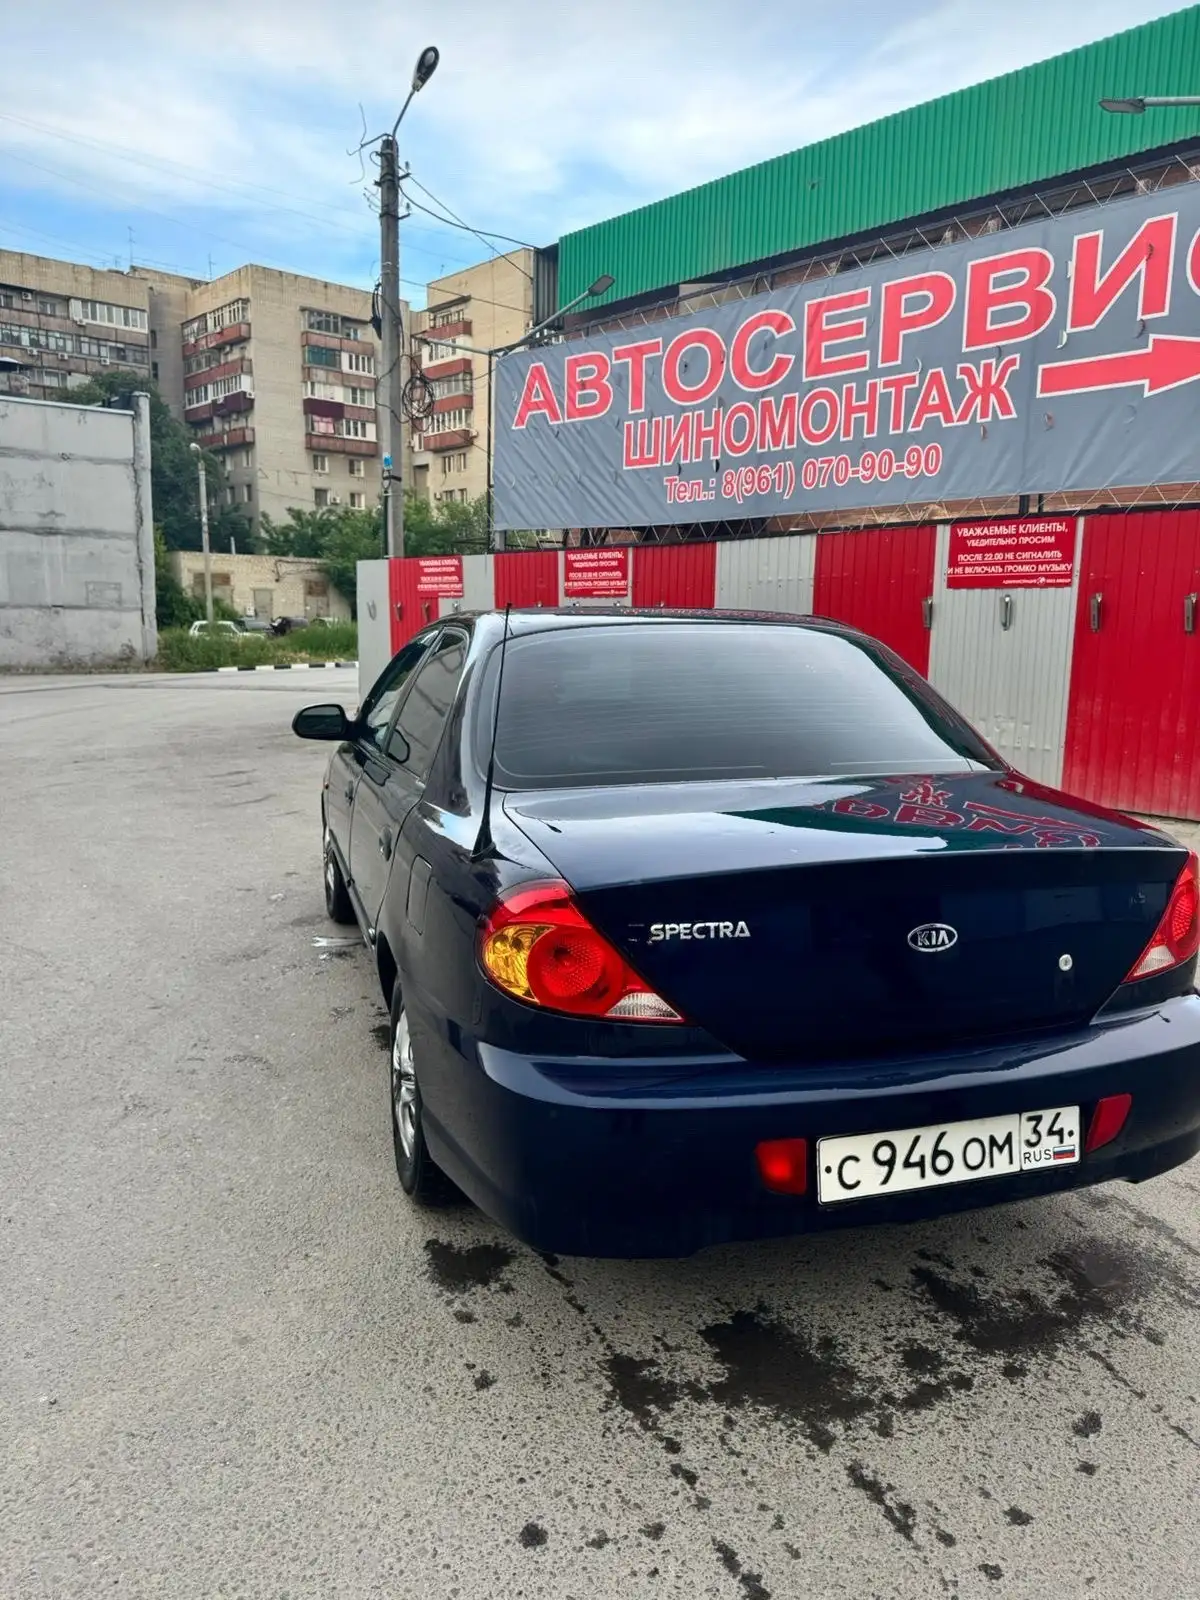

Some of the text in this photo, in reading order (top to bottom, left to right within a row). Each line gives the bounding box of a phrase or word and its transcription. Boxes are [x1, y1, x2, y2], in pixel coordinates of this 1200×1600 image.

[511, 212, 1200, 430] АВТОСЕРВИ
[622, 352, 1020, 470] ШИНОМОНТАЖ
[664, 443, 943, 503] Тел.: 8(961) 070-90-90
[957, 522, 1068, 537] УВАЖАЕМЫЕ КЛИЕНТЫ,
[967, 536, 1055, 547] УБЕДИТЕЛЬНО ПРОСИМ
[957, 553, 983, 562] ПОСЛЕ
[1016, 550, 1062, 560] СИГНАЛИТЬ
[954, 566, 964, 574] НЕ
[964, 565, 1003, 574] ВКЛЮЧАТЬ
[1004, 564, 1037, 573] ГРОМКО
[1038, 563, 1072, 572] МУЗЫКУ
[650, 920, 751, 941] SPECTRA
[917, 929, 950, 946] KIA
[1023, 1112, 1065, 1148] 34
[1023, 1148, 1052, 1165] RUS
